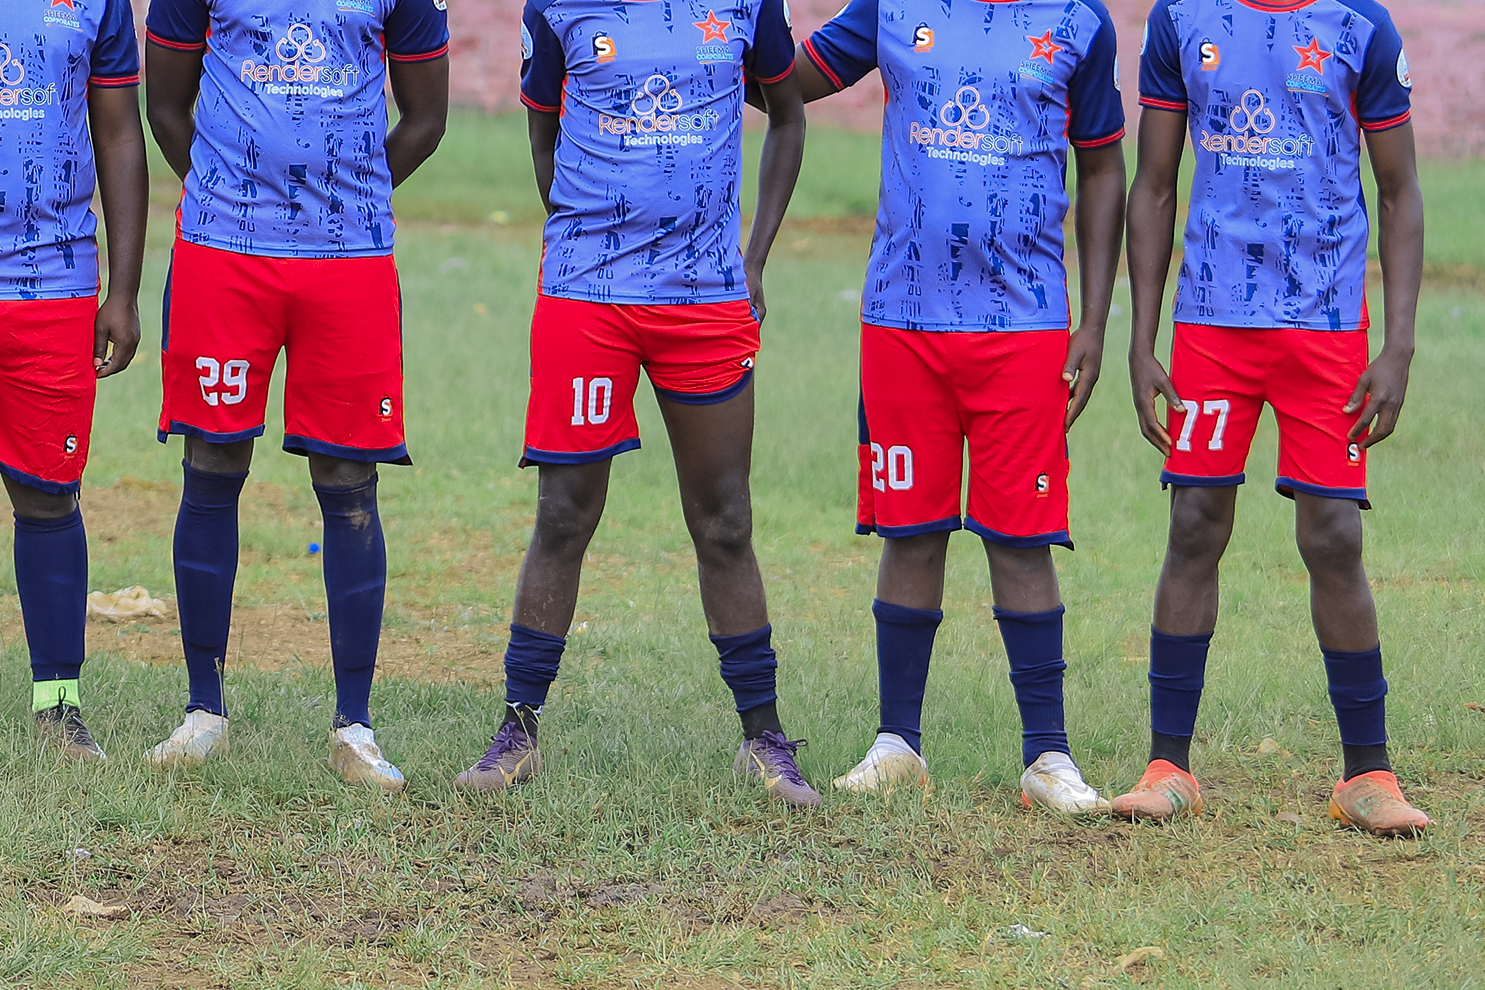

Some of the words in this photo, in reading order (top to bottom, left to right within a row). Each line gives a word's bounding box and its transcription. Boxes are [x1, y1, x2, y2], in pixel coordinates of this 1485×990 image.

[44, 9, 77, 21] SHEEMA
[595, 35, 611, 55] S
[915, 27, 930, 45] S
[696, 45, 731, 55] SHEEMA
[1201, 43, 1215, 63] S
[241, 60, 360, 87] Rendersoft
[265, 83, 344, 98] Technologies
[598, 109, 719, 136] Rendersoft
[623, 133, 703, 147] Technologies
[909, 122, 1024, 156] Rendersoft
[1198, 129, 1316, 157] Rendersoft
[926, 145, 1006, 167] Technologies
[1220, 153, 1295, 171] Technologies
[195, 356, 250, 406] 29
[571, 376, 613, 426] 10
[1175, 399, 1230, 452] 77
[870, 442, 914, 493] 20
